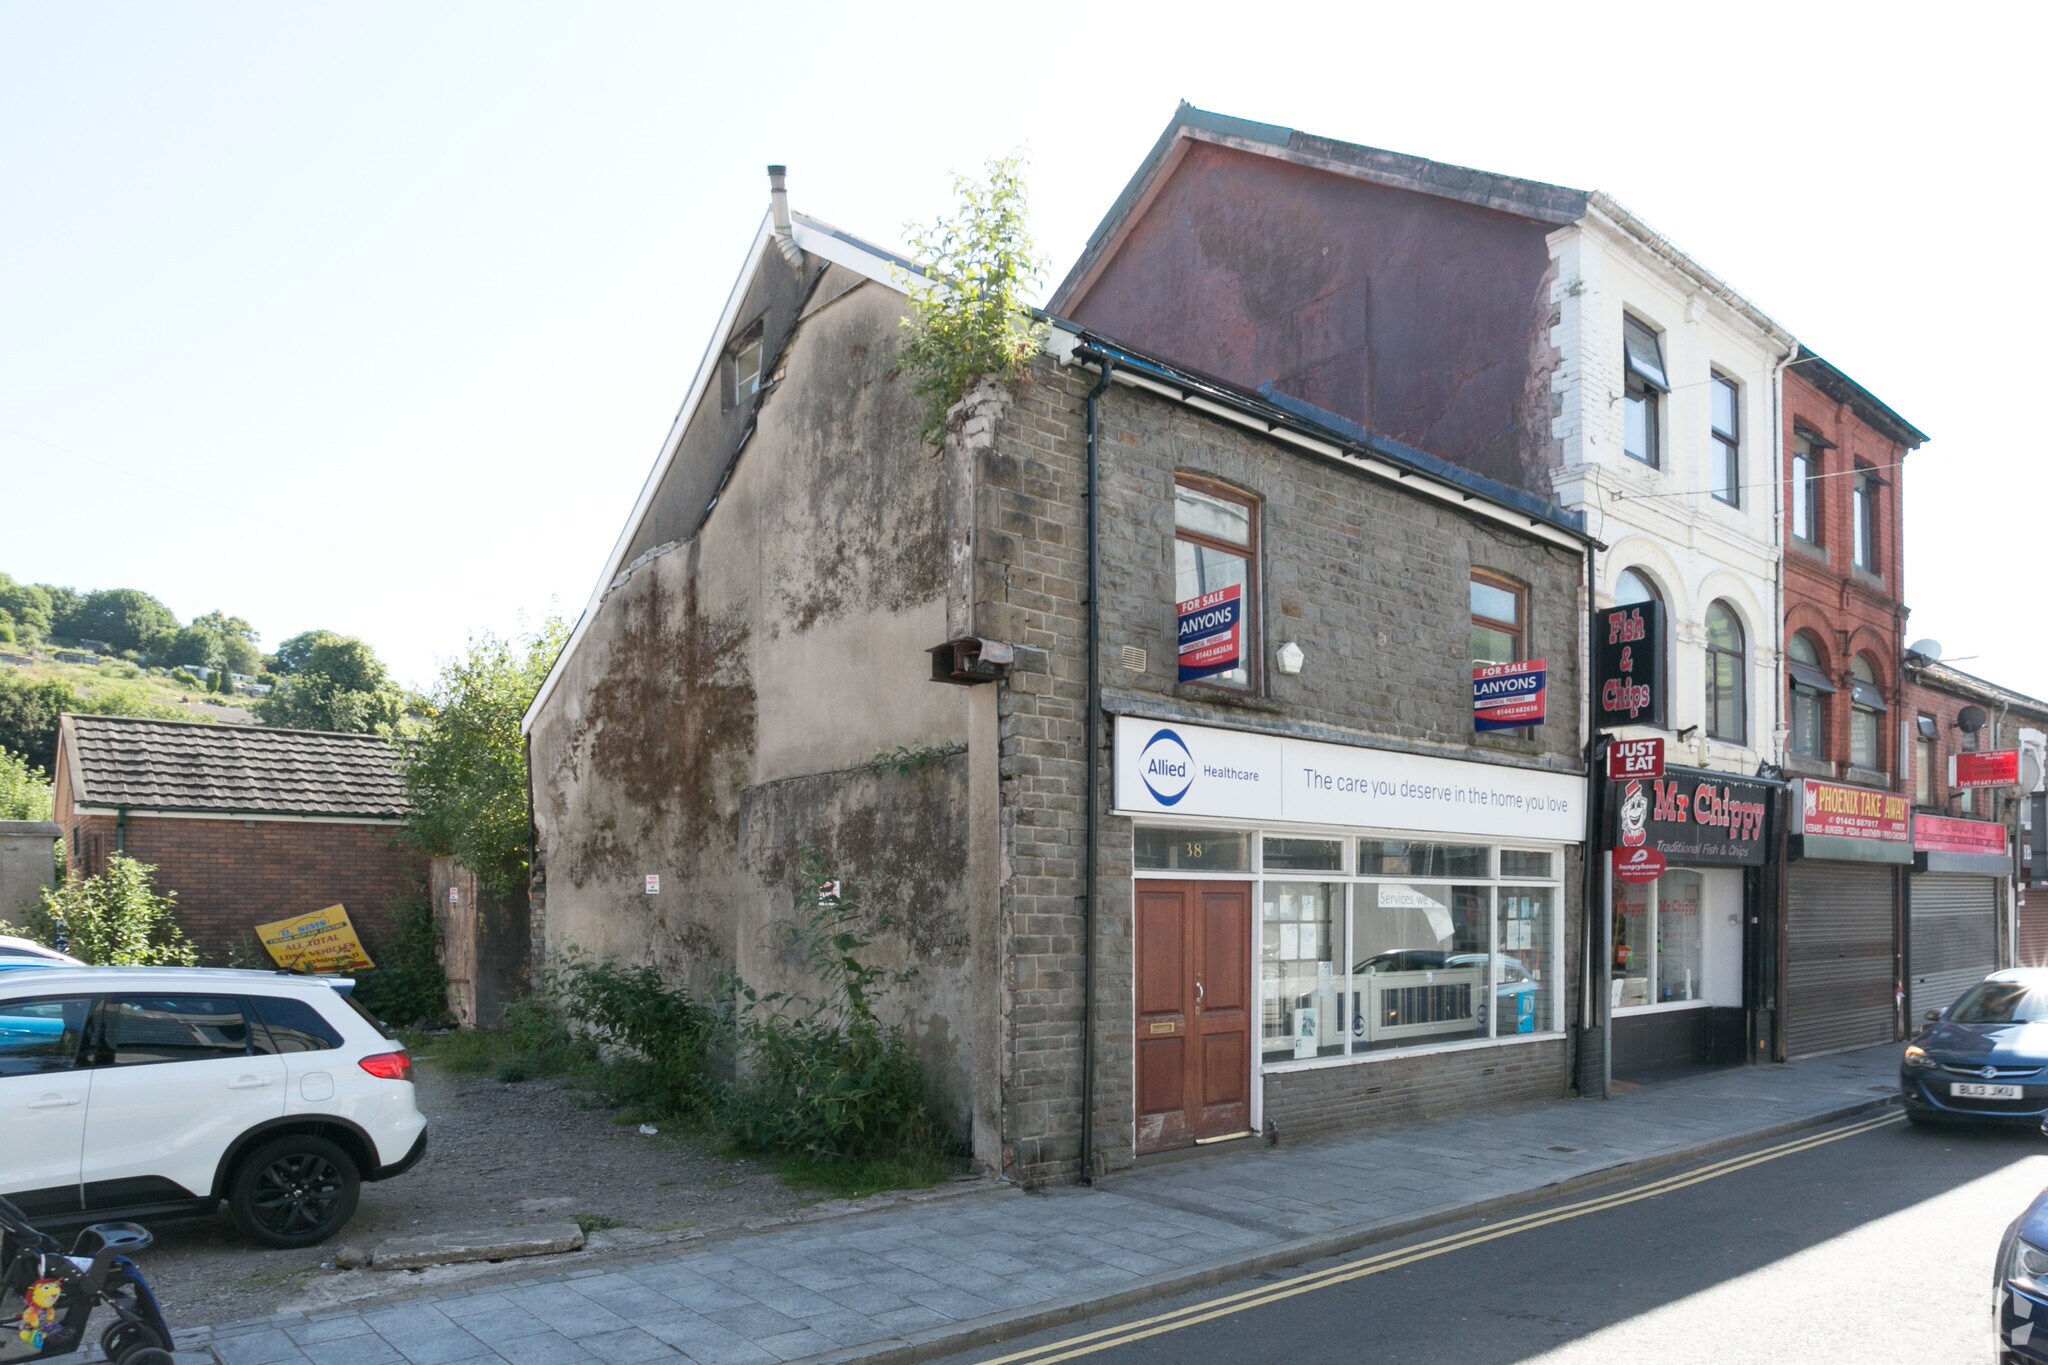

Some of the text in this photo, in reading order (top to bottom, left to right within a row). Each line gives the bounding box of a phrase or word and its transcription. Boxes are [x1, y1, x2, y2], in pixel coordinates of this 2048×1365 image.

[1182, 591, 1224, 613] FOR SALE
[1179, 606, 1232, 636] ANYONS
[1608, 607, 1645, 645] Fish
[1195, 650, 1212, 660] 01443
[1619, 646, 1633, 672] &
[1482, 662, 1528, 677] FOR SALE
[1473, 676, 1537, 696] LANYONS
[1602, 676, 1650, 719] Chips
[1496, 708, 1515, 716] 01443
[1515, 705, 1538, 713] 682636
[1615, 741, 1656, 758] JUST
[1148, 758, 1186, 777] Allied
[1625, 755, 1656, 771] EAT
[1203, 765, 1259, 781] Healthcare
[1303, 768, 1568, 812] The care you deserve in the home you love
[1653, 779, 1765, 840] Mr Chippy
[1819, 785, 1906, 820] PHOENIX TAKE AWAY
[1805, 823, 1823, 833] KEBABS
[1825, 825, 1844, 835] BURGERS
[1835, 816, 1879, 828] 01443 687017
[1186, 842, 1202, 857] 38
[1656, 840, 1750, 858] Traditional Fish & Chips
[1618, 863, 1661, 871] hungryhouse
[1380, 891, 1414, 904] Services
[1417, 896, 1428, 905] we
[298, 919, 327, 932] SIMS
[285, 934, 341, 951] ALL TOTAL
[308, 942, 356, 956] VEHICLES
[1959, 1084, 1985, 1096] BL13
